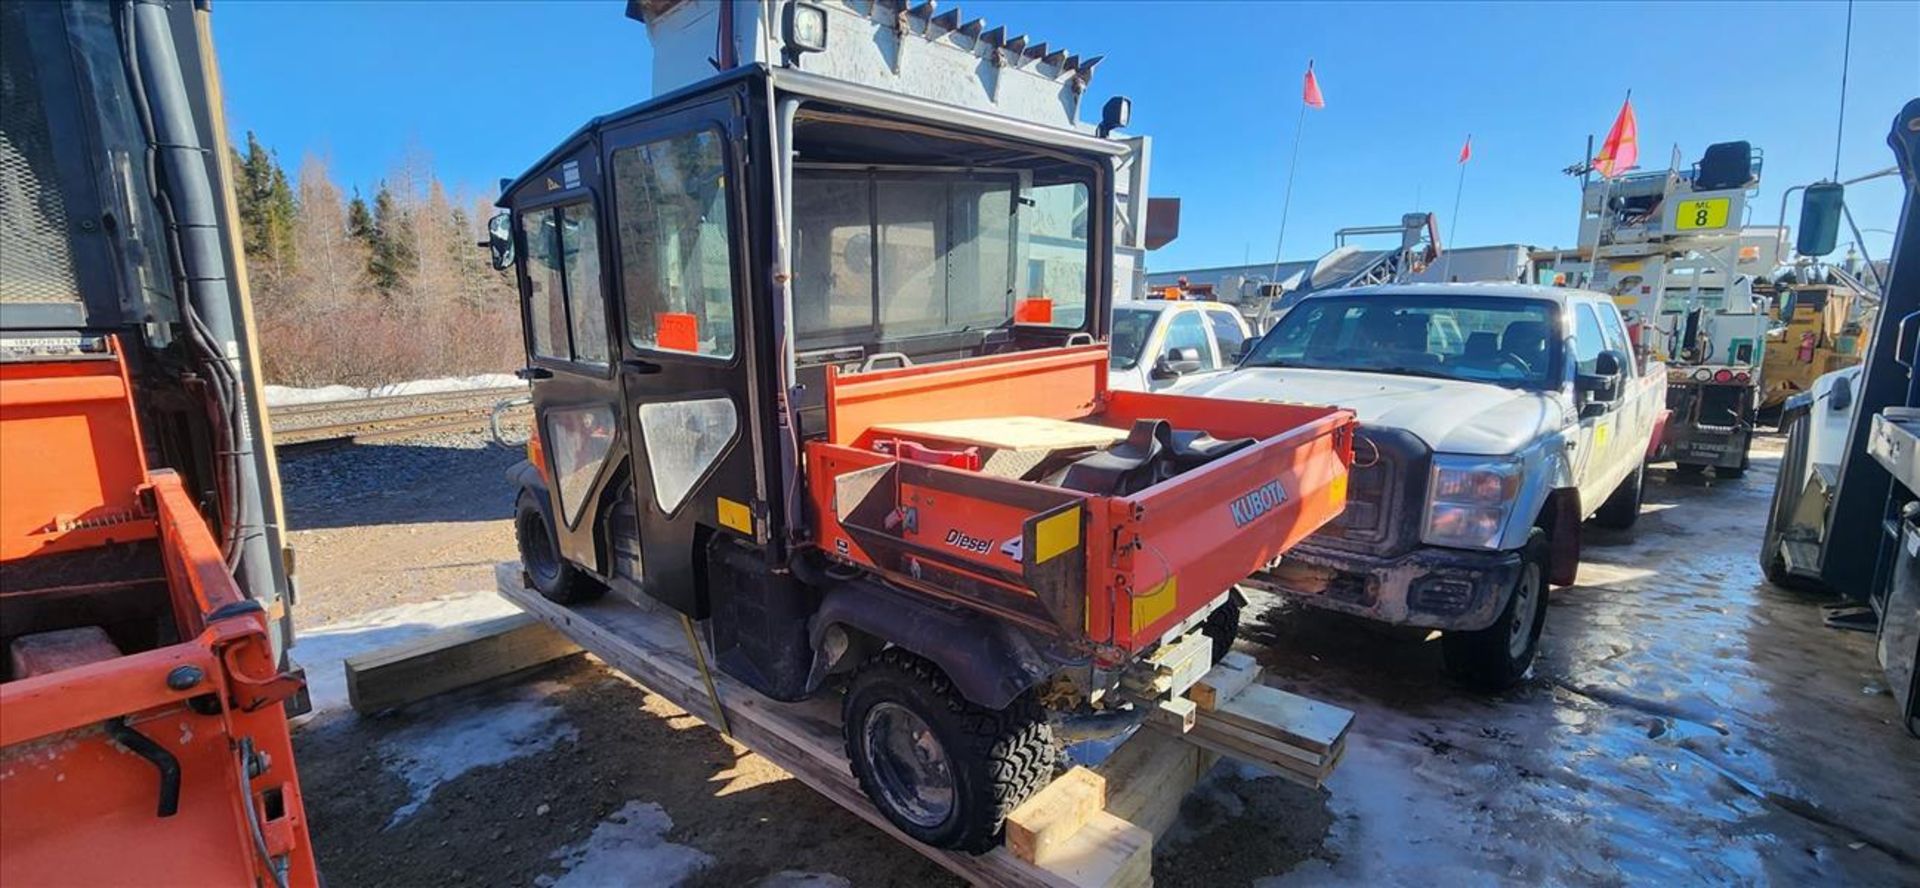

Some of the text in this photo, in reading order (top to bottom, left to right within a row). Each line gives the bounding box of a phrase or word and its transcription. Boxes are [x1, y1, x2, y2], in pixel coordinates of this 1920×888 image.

[1696, 210, 1708, 226] 8
[14, 338, 80, 346] IMPORTAN
[1231, 479, 1288, 528] KUBOTA
[946, 529, 994, 555] Diesel
